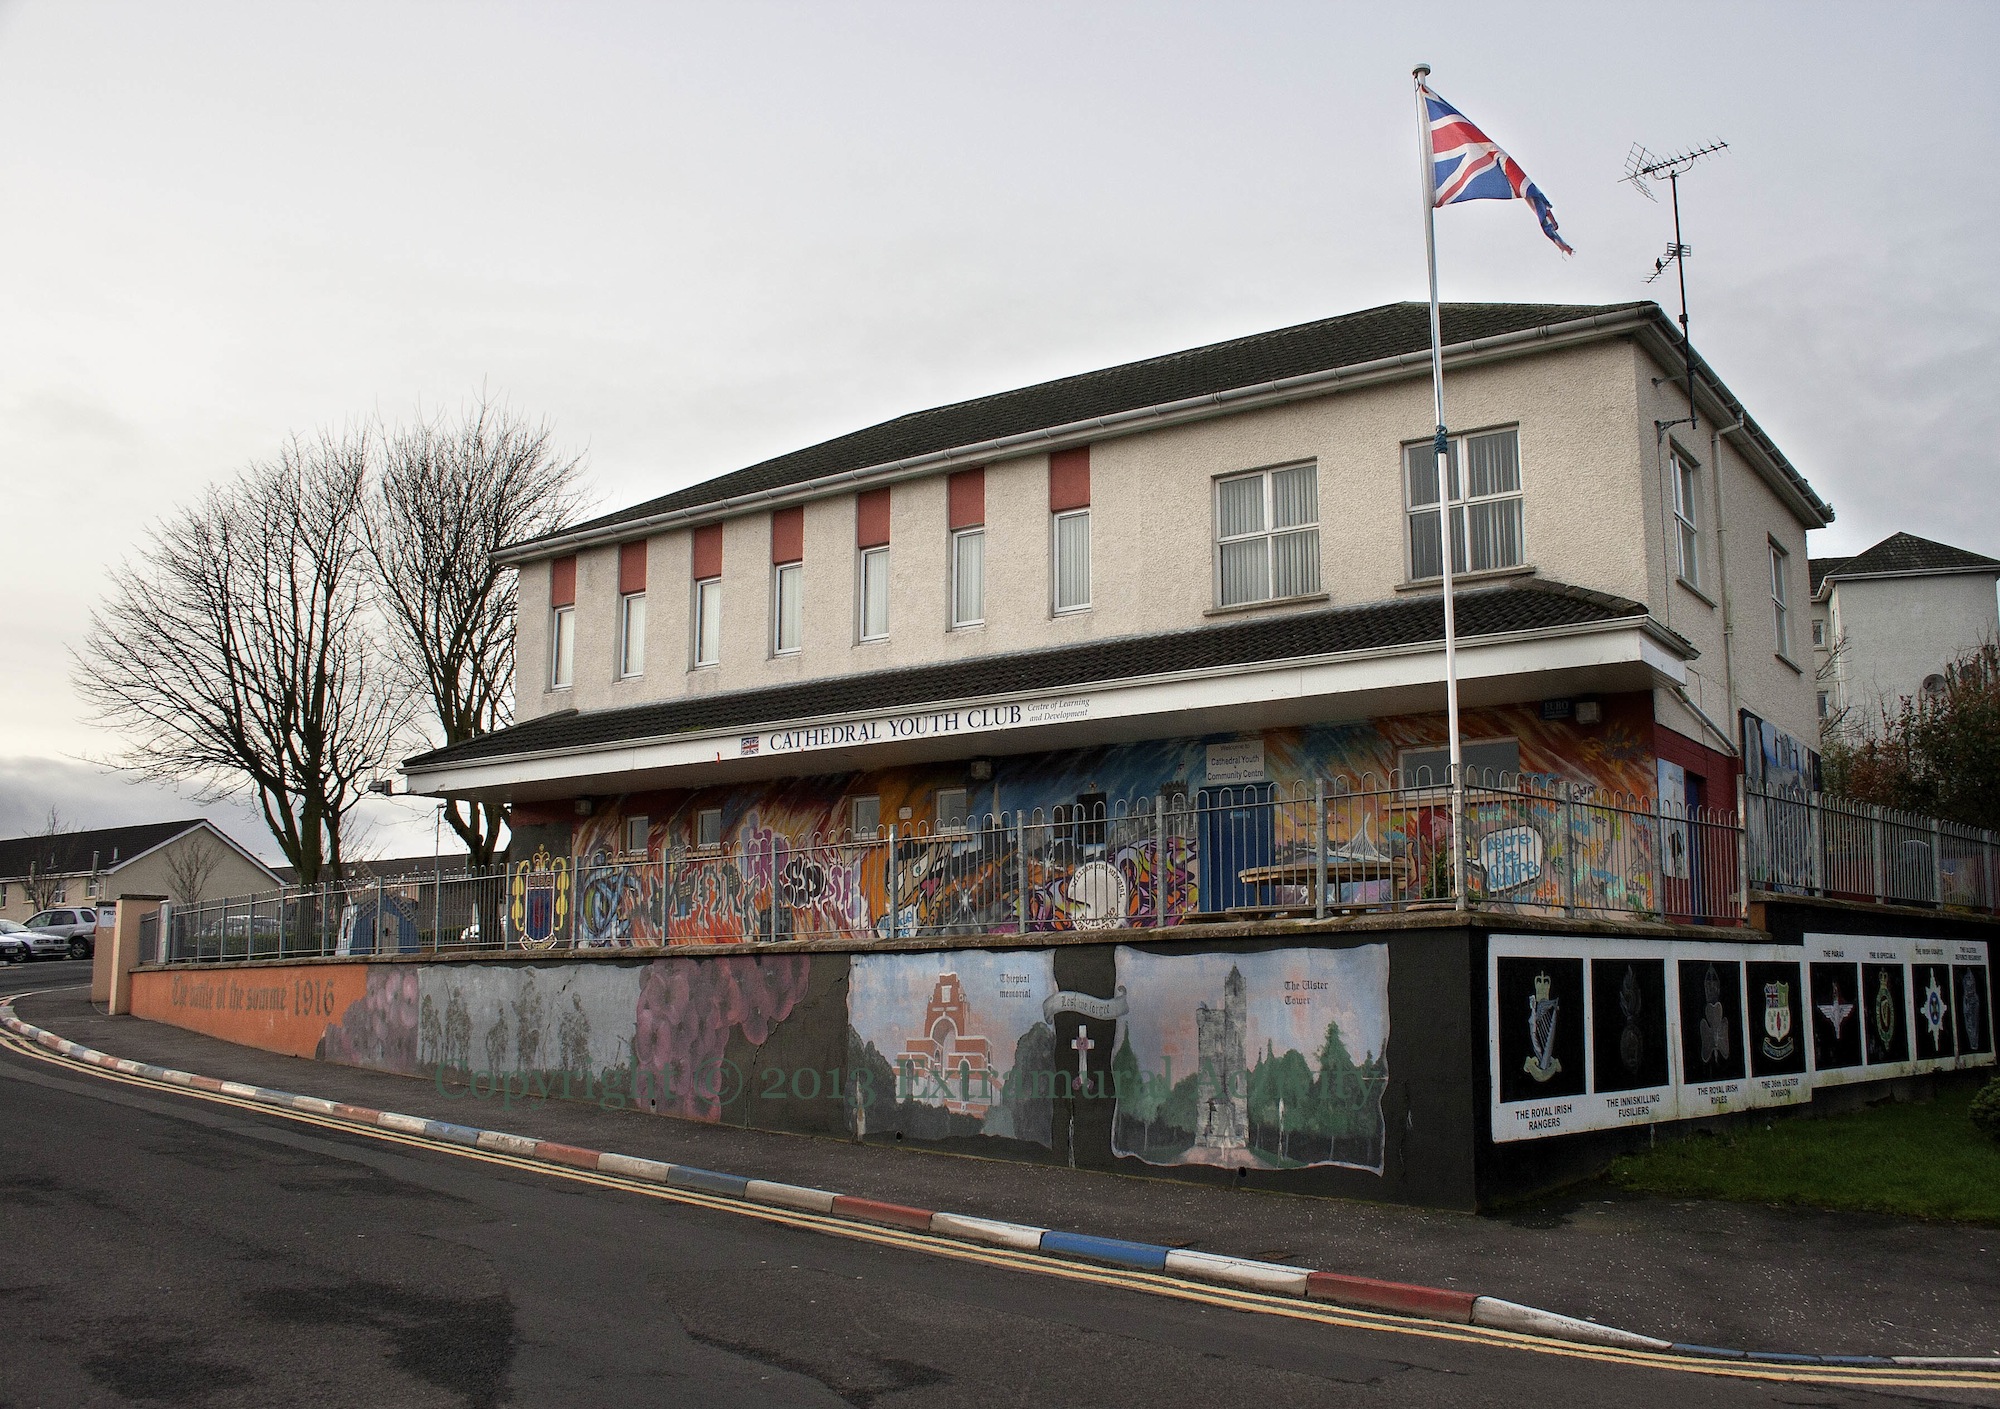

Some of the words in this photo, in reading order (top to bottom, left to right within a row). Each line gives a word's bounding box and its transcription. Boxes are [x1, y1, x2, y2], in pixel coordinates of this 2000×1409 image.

[1027, 703, 1050, 712] Centre
[1050, 700, 1058, 711] of
[1058, 698, 1090, 708] Learning
[1029, 714, 1043, 722] and
[1043, 709, 1088, 721] Development
[770, 721, 882, 751] CATHEDRAL
[888, 712, 959, 738] YOUTH
[967, 705, 1022, 728] CLUB
[1220, 744, 1246, 752] Welcome
[1211, 756, 1241, 766] Cathedral
[1241, 754, 1260, 764] Youth
[1207, 770, 1243, 781] Community
[1243, 769, 1264, 779] Centre
[1823, 950, 1831, 958] THE
[1284, 981, 1300, 992] The
[1301, 980, 1329, 991] Ulster
[294, 979, 335, 1017] 1916
[999, 989, 1031, 999] memorial
[1061, 995, 1077, 1008] Lest
[1284, 995, 1310, 1006] Tower
[1697, 1087, 1708, 1096] THE
[1708, 1085, 1725, 1095] ROYAL
[1725, 1084, 1739, 1094] IRISH
[1761, 1081, 1771, 1090] THE
[1782, 1078, 1799, 1087] ULSTER
[1770, 1089, 1791, 1098] DIVISION
[1606, 1098, 1619, 1109] THE
[1620, 1094, 1660, 1107] INNISKILLING
[1710, 1096, 1728, 1105] RIFLES
[1515, 1110, 1530, 1121] THE
[1530, 1107, 1553, 1120] ROYAL
[1554, 1104, 1573, 1116] IRISH
[1618, 1106, 1650, 1118] FUSILIERS
[1528, 1117, 1561, 1132] RANGERS
